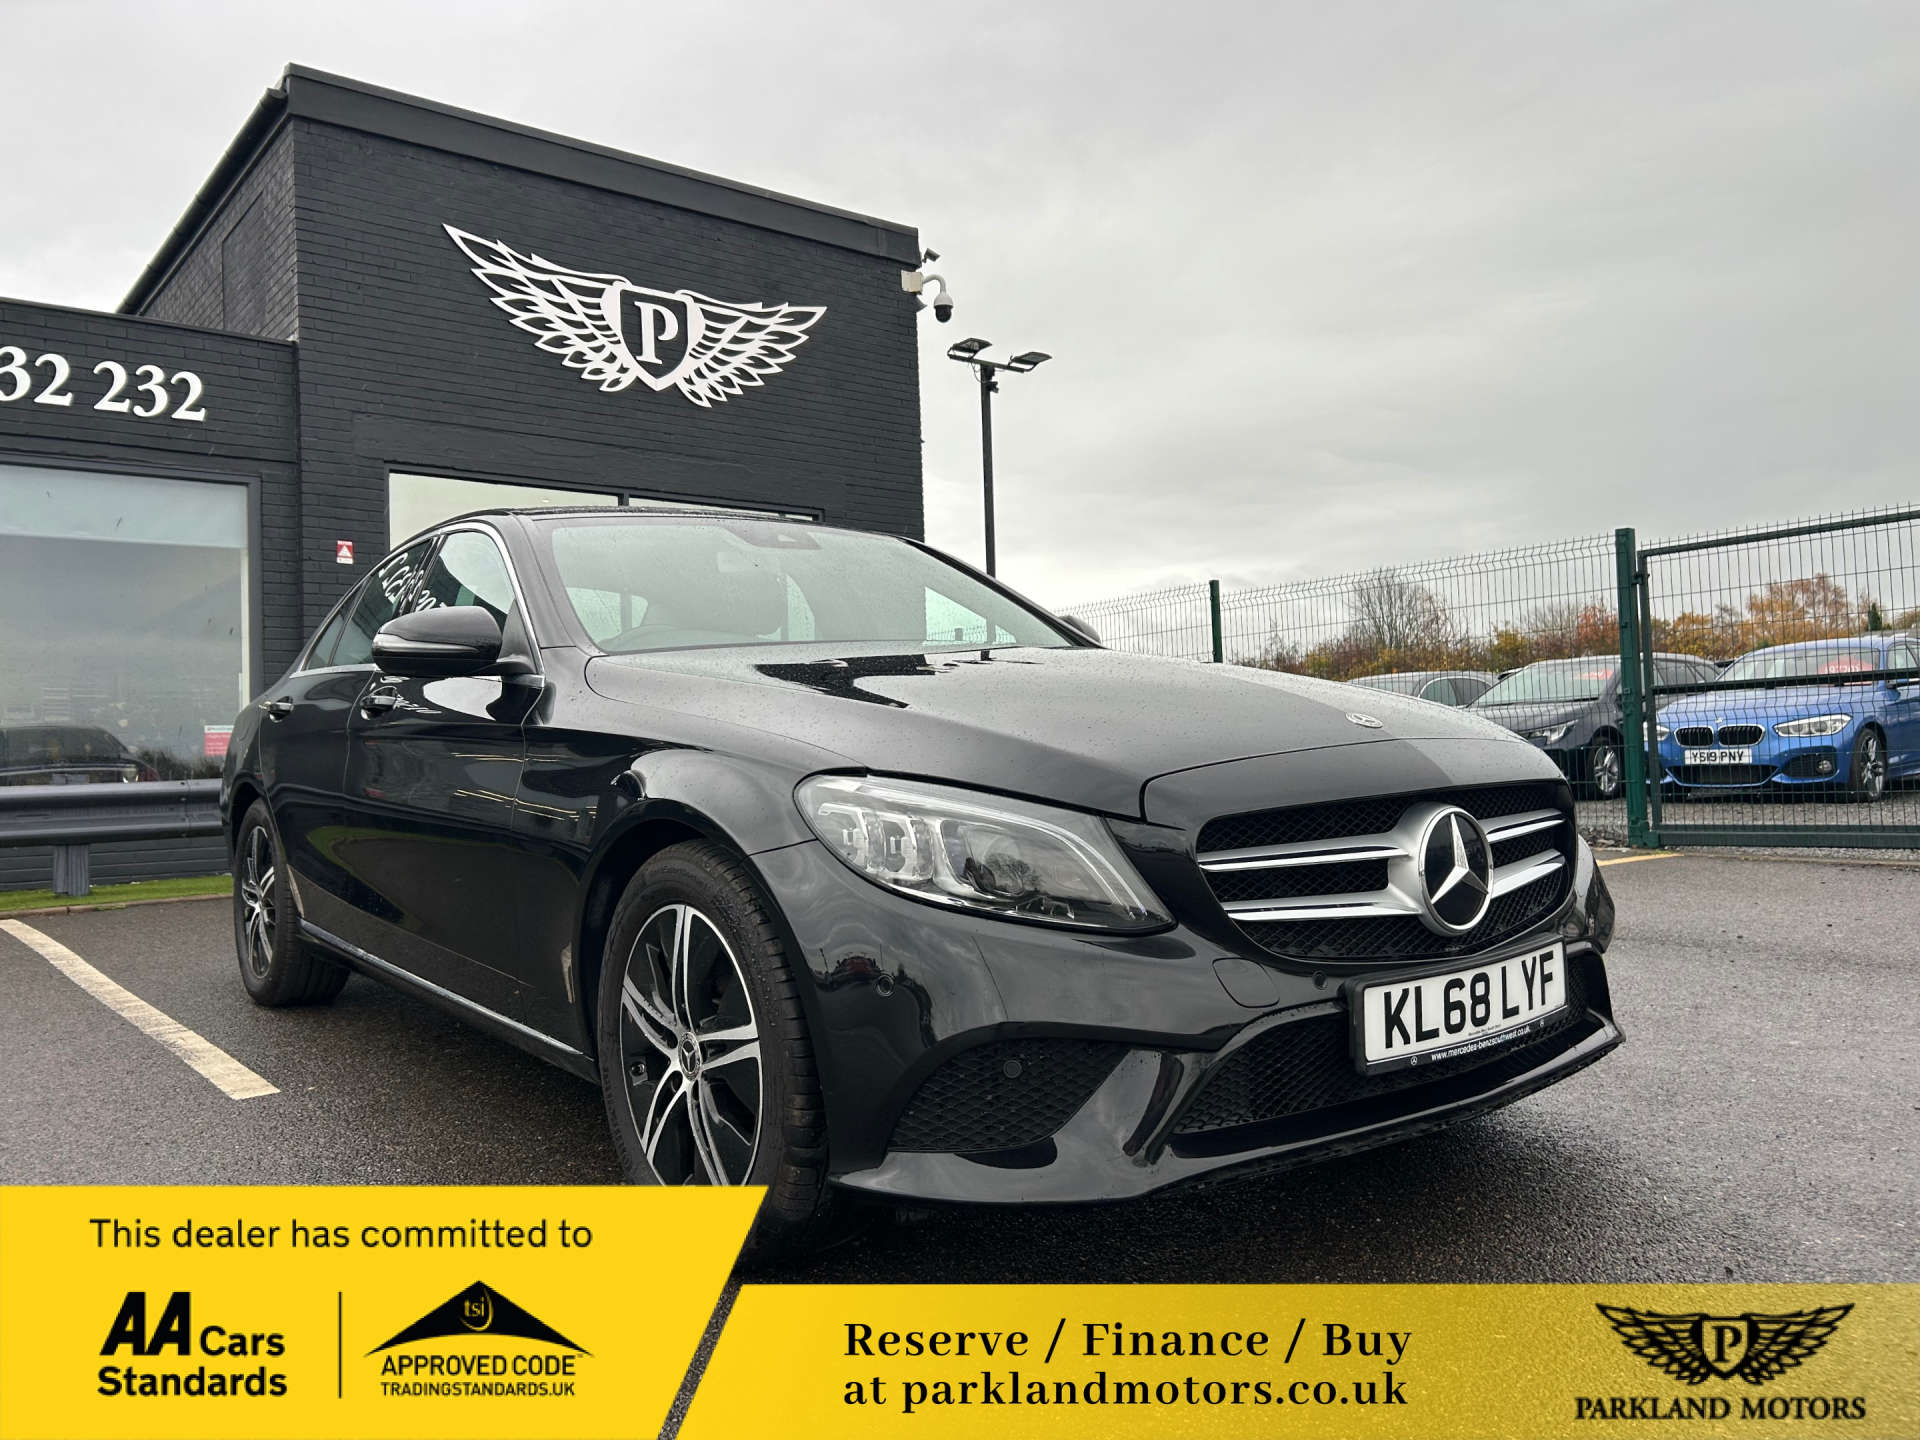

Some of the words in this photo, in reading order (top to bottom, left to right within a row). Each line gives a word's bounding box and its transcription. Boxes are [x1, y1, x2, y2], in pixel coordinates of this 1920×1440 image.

[633, 300, 679, 365] P
[93, 360, 207, 422] 232
[1383, 972, 1490, 1050] KL68
[1500, 949, 1555, 1020] LYF
[1430, 1025, 1531, 1062] www.mercedes-benzsouthwest.co.uk
